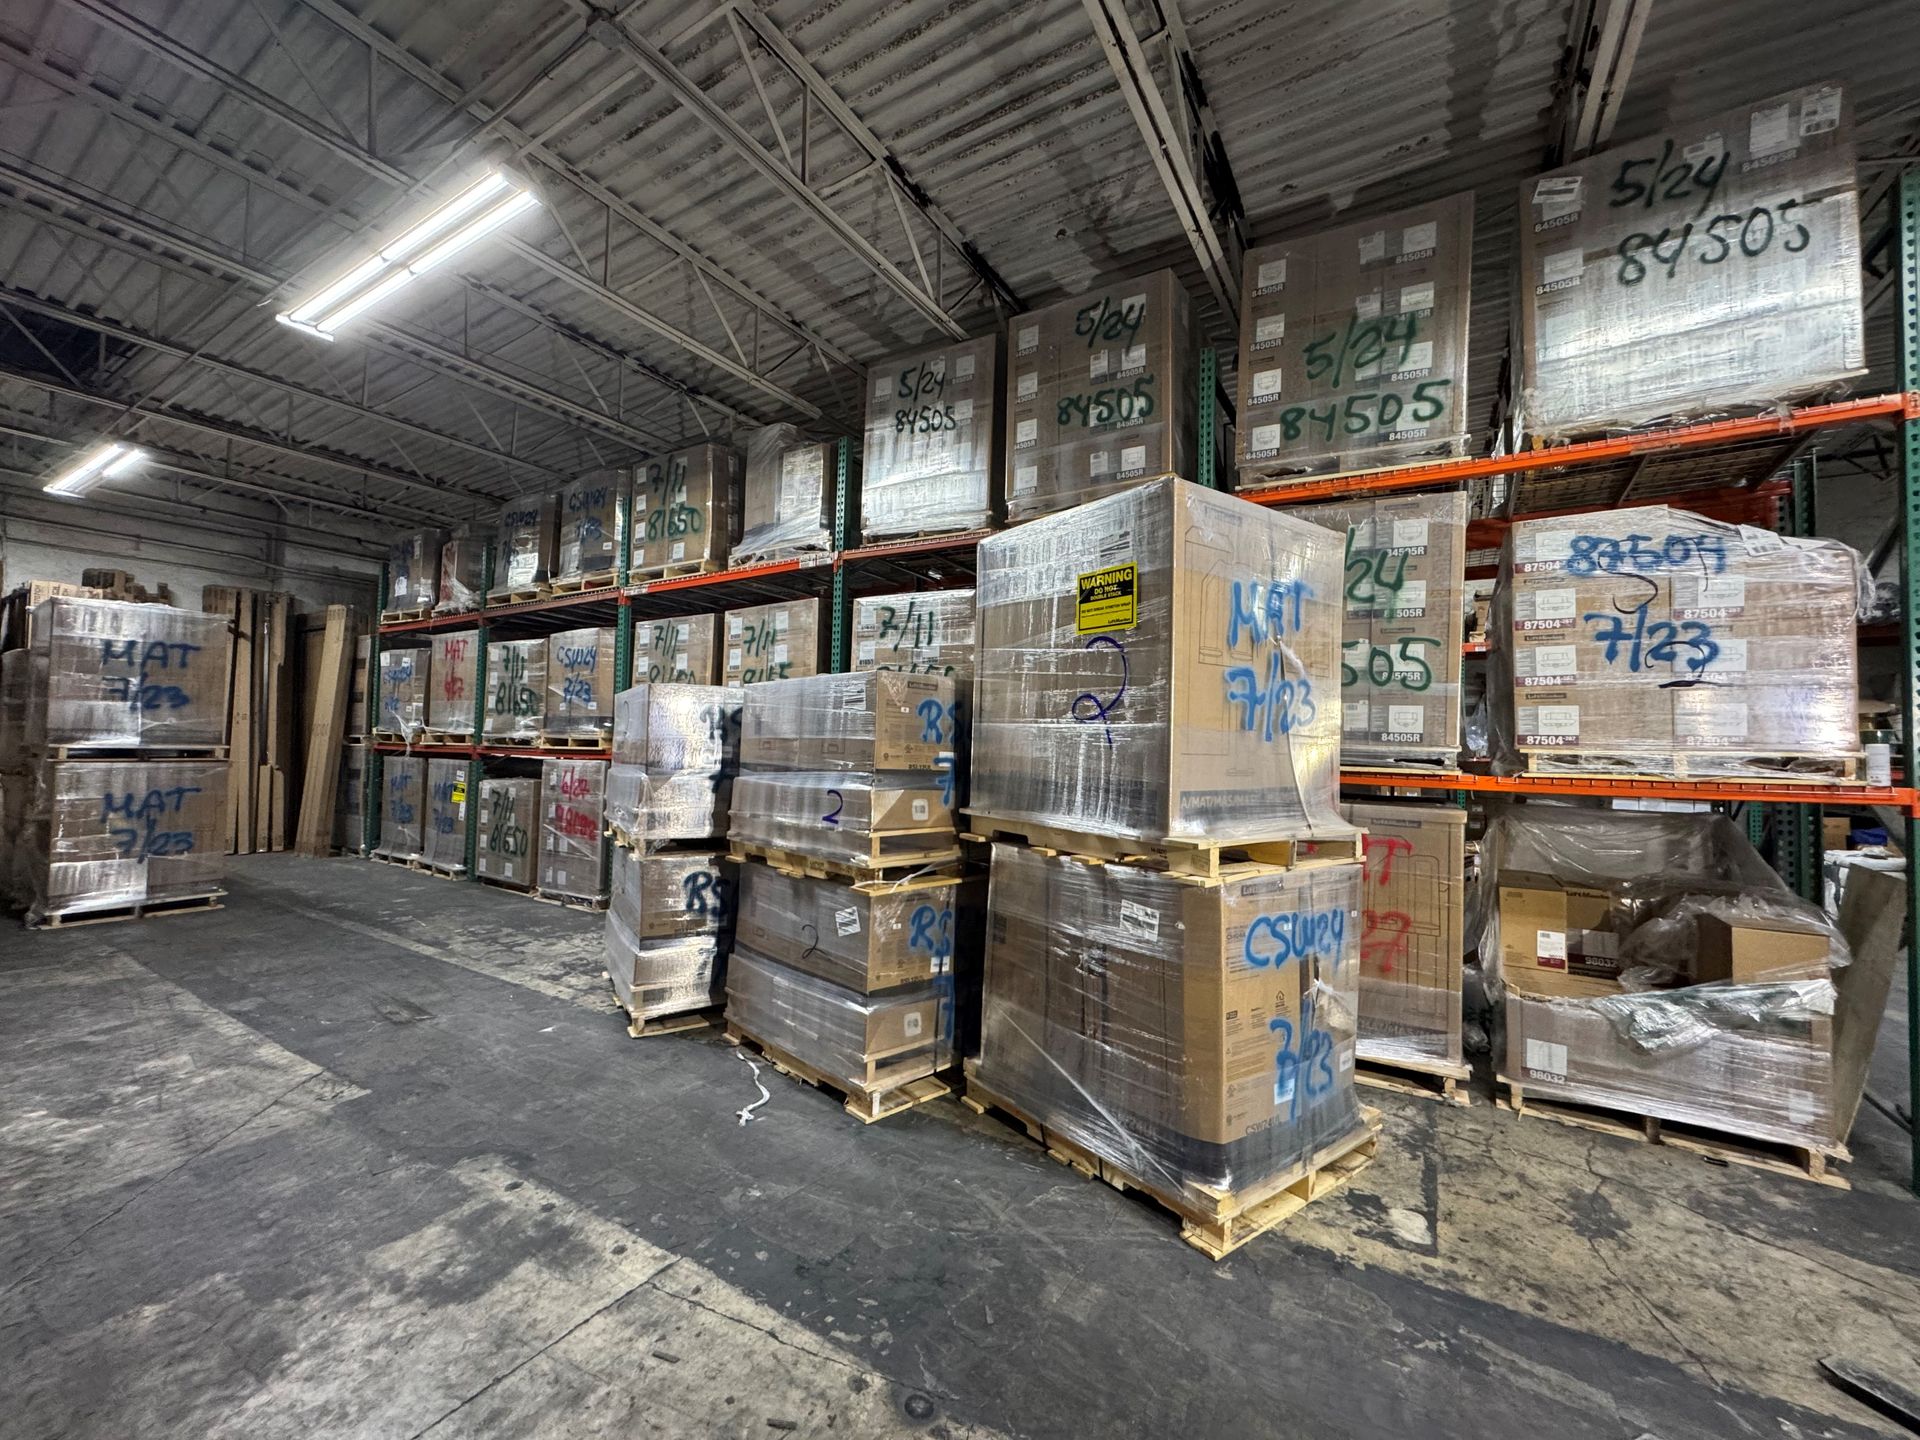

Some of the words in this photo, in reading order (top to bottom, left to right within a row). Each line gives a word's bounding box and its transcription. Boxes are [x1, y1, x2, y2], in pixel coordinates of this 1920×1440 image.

[1610, 138, 1731, 216] 5/24
[1535, 212, 1578, 232] 84505R
[1617, 199, 1824, 286] 84505
[1536, 277, 1580, 295] 84505R
[1074, 296, 1146, 356] 5/24
[1250, 339, 1281, 352] 84505R
[1303, 306, 1417, 388] 5/24
[899, 362, 945, 402] 5/24
[1117, 367, 1144, 379] 84505R
[1391, 369, 1429, 382] 84505R
[1057, 374, 1154, 427] 84505
[1248, 393, 1279, 406] 84505R
[1280, 380, 1452, 442] 84505
[896, 405, 956, 434] 84505
[1389, 429, 1427, 441] 84505R
[1246, 449, 1277, 460] 84505R
[650, 454, 686, 505] 7/11
[1117, 469, 1144, 479] 84505R
[1081, 569, 1132, 590] WARNING
[1104, 585, 1118, 593] NOT
[879, 598, 934, 652] 7/11
[1229, 579, 1314, 648] MAT
[101, 637, 201, 668] MAT
[654, 620, 680, 660] 7/11
[743, 619, 777, 657] 7/11
[1584, 603, 1720, 673] 7/23
[502, 645, 524, 684] 7/11
[102, 672, 190, 711] 7/23
[1225, 652, 1316, 743] 7/23
[1381, 733, 1421, 743] 84505R
[101, 787, 202, 822] MAT
[822, 790, 844, 824] 2
[109, 813, 193, 864] 7/23
[1245, 908, 1344, 974] CSW24
[1530, 1070, 1565, 1084] 98032
